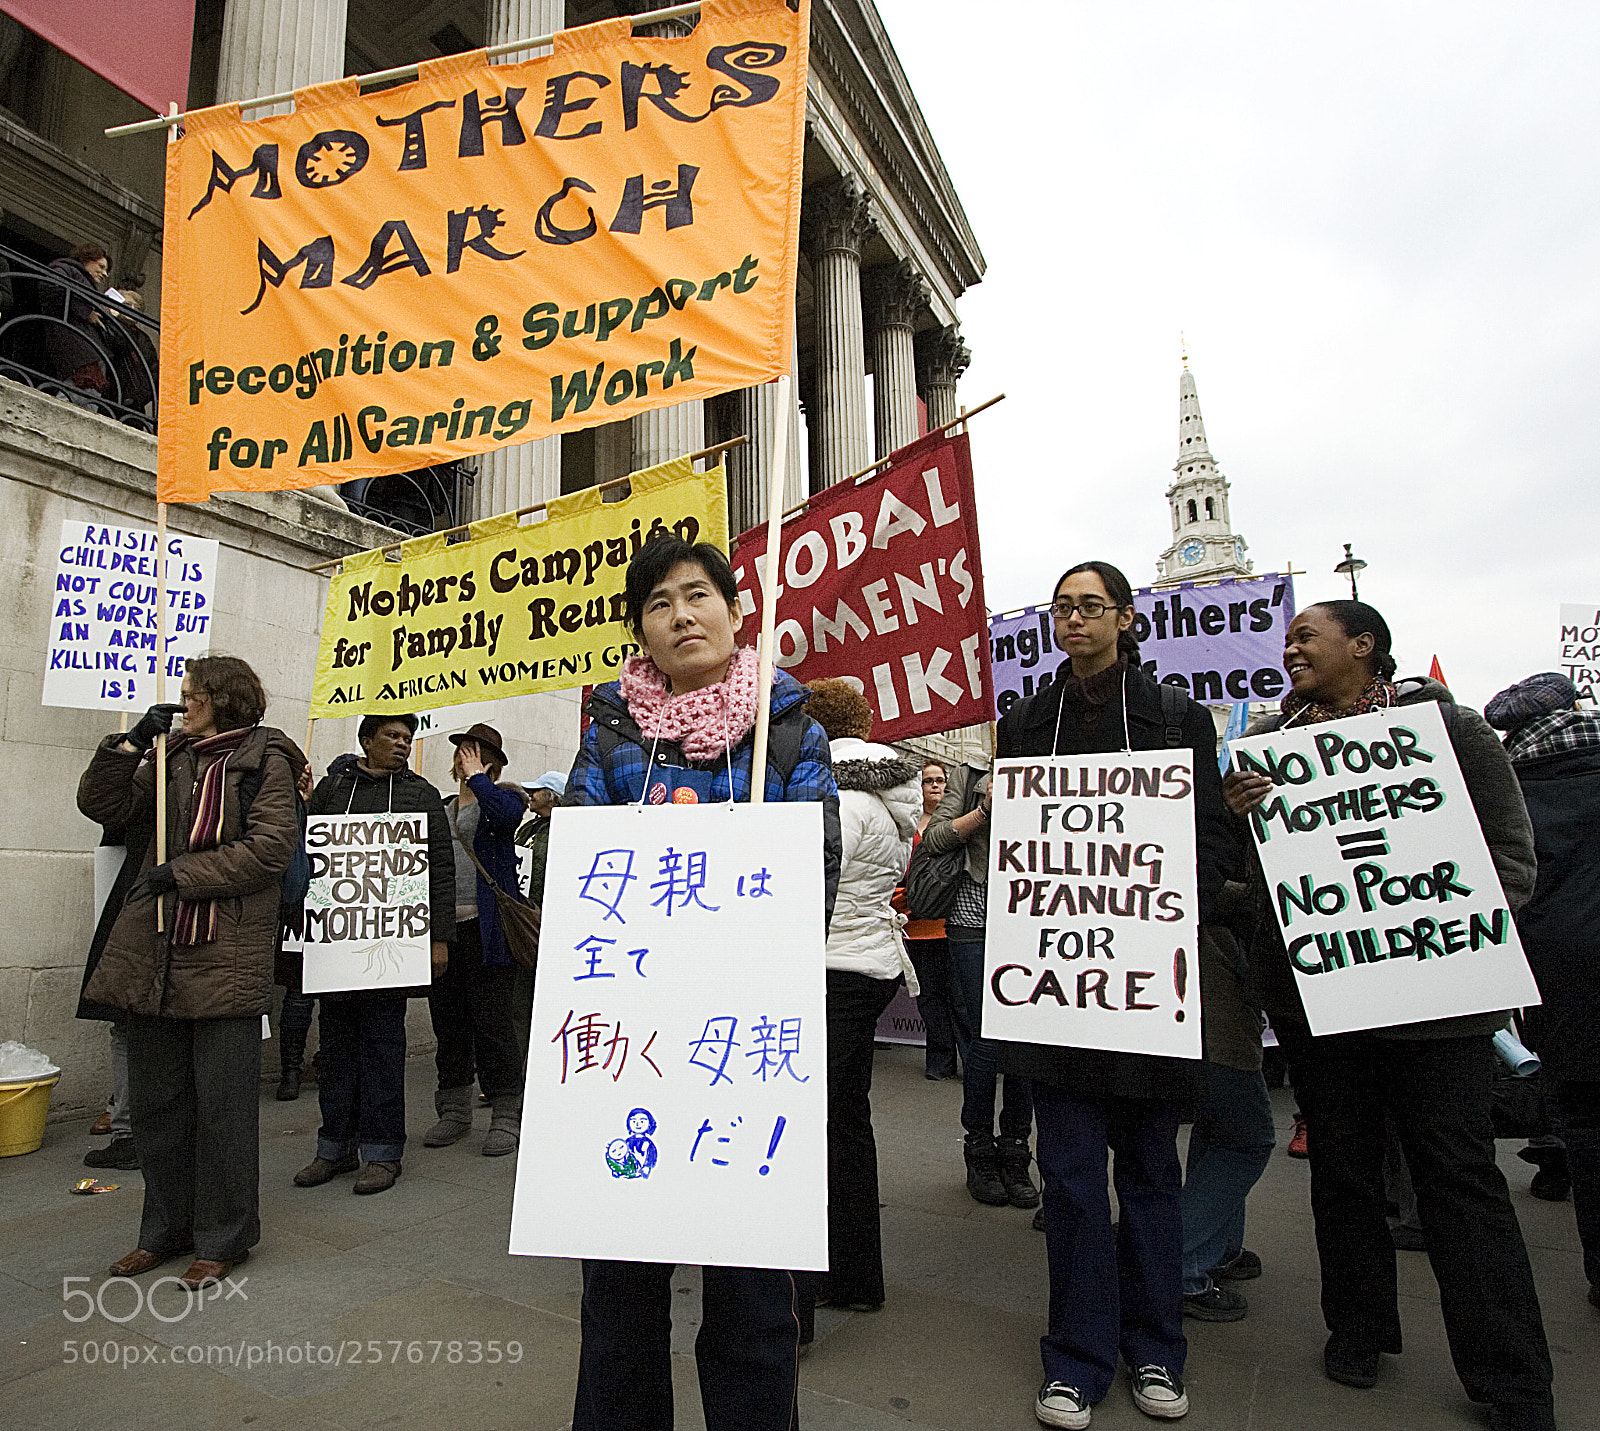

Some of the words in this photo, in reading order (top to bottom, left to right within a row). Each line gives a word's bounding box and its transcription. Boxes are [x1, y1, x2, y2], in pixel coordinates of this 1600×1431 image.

[188, 41, 787, 221] MOTHERS
[240, 164, 700, 315] MARCH
[472, 314, 502, 362] &
[522, 254, 759, 351] Support
[207, 427, 288, 471] for
[298, 412, 352, 467] All
[357, 398, 533, 453] Caring
[550, 337, 697, 423] Work
[57, 573, 100, 594] NOT
[182, 563, 202, 582] IS
[56, 599, 86, 617] AS
[97, 602, 157, 629] WORK
[176, 613, 209, 633] BUT
[757, 548, 973, 668] OMEN'S
[1134, 584, 1285, 642] others'
[59, 622, 89, 641] AN
[332, 638, 371, 668] for
[392, 610, 503, 671] Family
[50, 649, 137, 672] KILLING
[328, 684, 365, 704] ALL
[375, 669, 467, 700] AFRICAN
[478, 651, 592, 686] WOMEN'S
[101, 679, 135, 700] IS!
[1314, 725, 1437, 776] POOR
[998, 765, 1192, 799] TRILLIONS
[1040, 802, 1124, 834] FOR
[1250, 777, 1446, 844] MOTHERS
[307, 820, 428, 847] SURVIVAL
[307, 849, 428, 878] DEPENDS
[998, 840, 1164, 884] KILLING
[331, 878, 390, 904] ON
[578, 847, 773, 924] 母親は
[1008, 879, 1184, 922] PEANUTS
[1353, 861, 1475, 912] POOR
[304, 903, 430, 943] MOTHERS
[1038, 927, 1115, 961] FOR
[1287, 909, 1509, 975] CHILDREN
[573, 935, 649, 981] 全て
